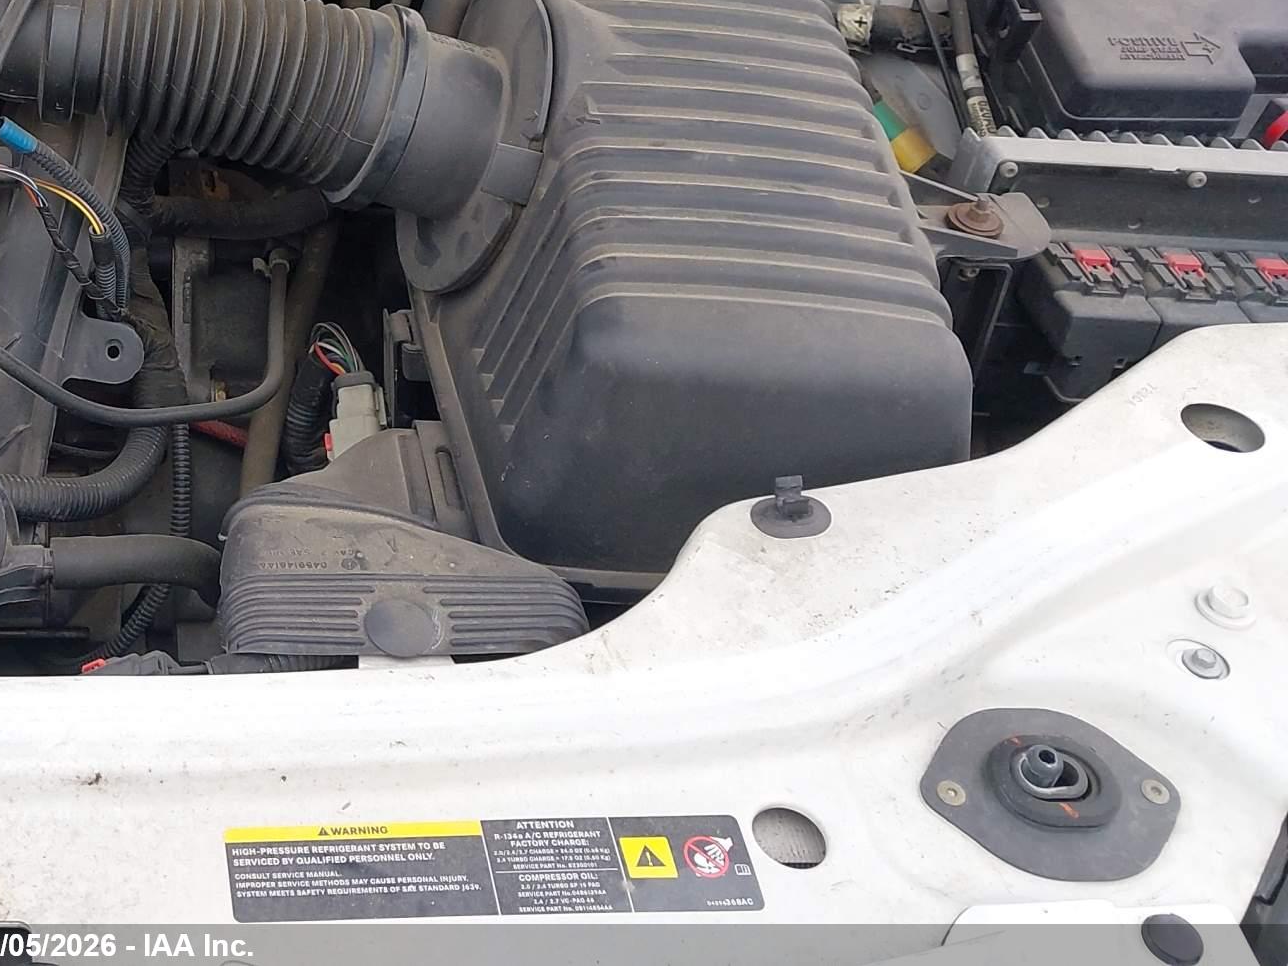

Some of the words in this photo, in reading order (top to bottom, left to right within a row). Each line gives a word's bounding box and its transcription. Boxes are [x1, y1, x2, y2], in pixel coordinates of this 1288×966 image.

[516, 821, 574, 830] ATTENTION
[330, 826, 388, 835] WARNING
[510, 839, 549, 847] FACTORY
[232, 846, 310, 856] HIGH-PRESSURE
[312, 844, 376, 854] REFRIGERANT
[378, 842, 416, 852] SYSTEM
[418, 842, 431, 850] TO
[432, 841, 446, 850] BE
[233, 858, 280, 867] SERVICED
[282, 857, 293, 865] BY
[296, 856, 347, 865] QUALIFIED
[349, 854, 406, 863] PERSONNEL
[408, 853, 435, 861] ONLY.
[272, 871, 305, 879] SERVICE
[306, 870, 342, 878] MANUAL.
[518, 874, 579, 882] COMPRESSOR
[236, 881, 275, 889] IMPROPER
[277, 880, 310, 888] SERVICE
[312, 879, 350, 887] METHODS
[351, 877, 368, 885] MAY
[398, 875, 438, 883] PERSONAL
[327, 886, 388, 895] REQUIREMENTS
[389, 885, 400, 893] OF
